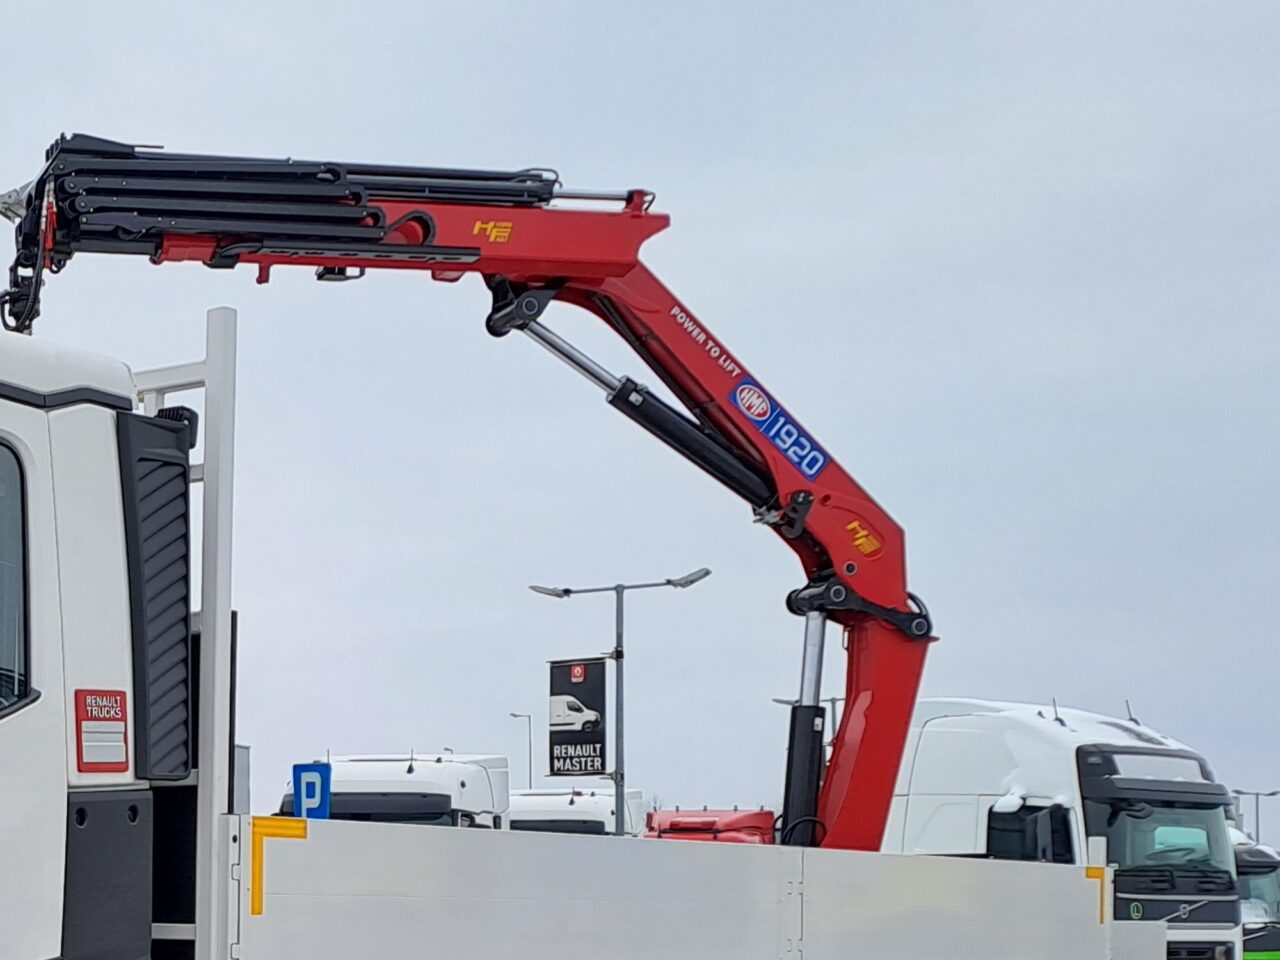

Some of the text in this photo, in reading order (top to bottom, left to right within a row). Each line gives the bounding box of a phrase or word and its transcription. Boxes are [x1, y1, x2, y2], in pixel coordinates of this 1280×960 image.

[670, 306, 742, 378] POWER TO LIFT
[739, 387, 825, 476] HMF 1920
[86, 695, 122, 707] RENAULT
[86, 706, 122, 718] TRUCKS
[553, 744, 602, 758] RENAULT
[553, 757, 602, 771] MASTER
[301, 771, 322, 818] P
